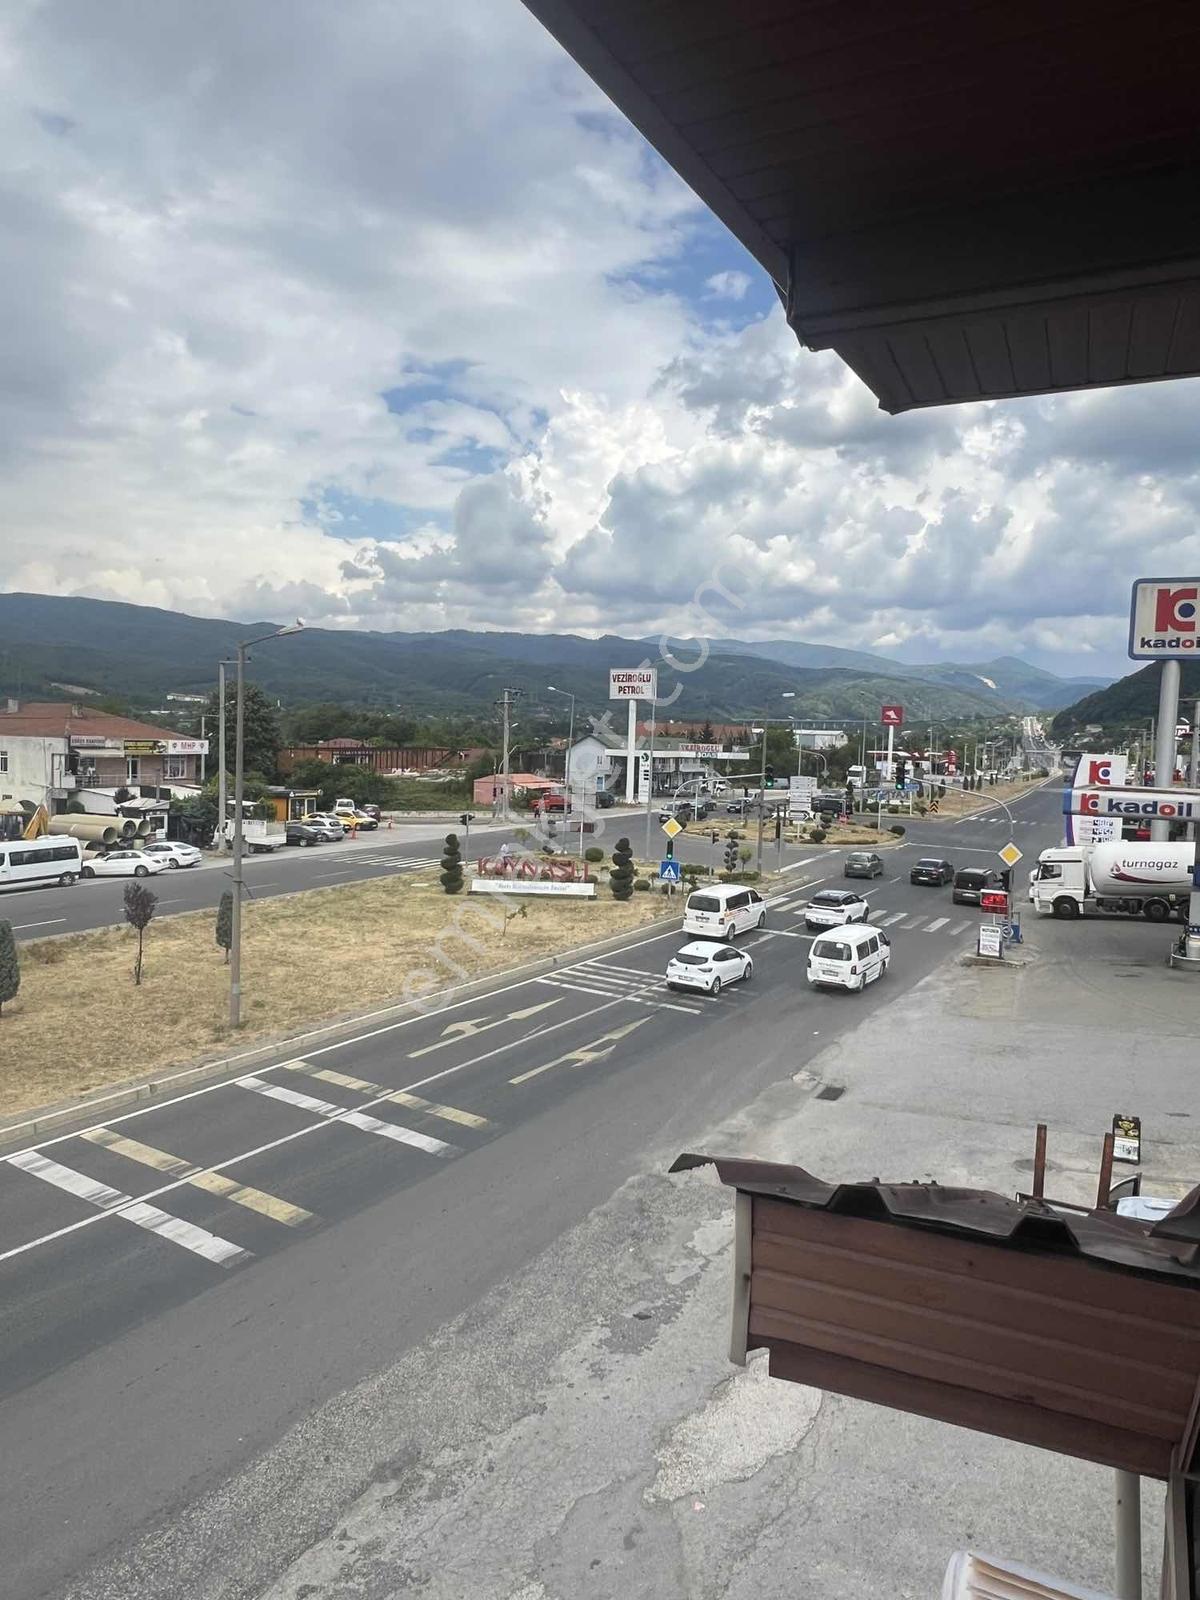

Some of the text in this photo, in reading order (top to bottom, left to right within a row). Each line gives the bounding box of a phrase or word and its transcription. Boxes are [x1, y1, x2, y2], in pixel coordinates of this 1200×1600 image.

[612, 672, 652, 683] VEZİROĞLU
[618, 685, 645, 695] PETROL
[181, 741, 196, 750] MHP
[1107, 798, 1193, 817] kadoil
[1122, 859, 1179, 871] turnagaz
